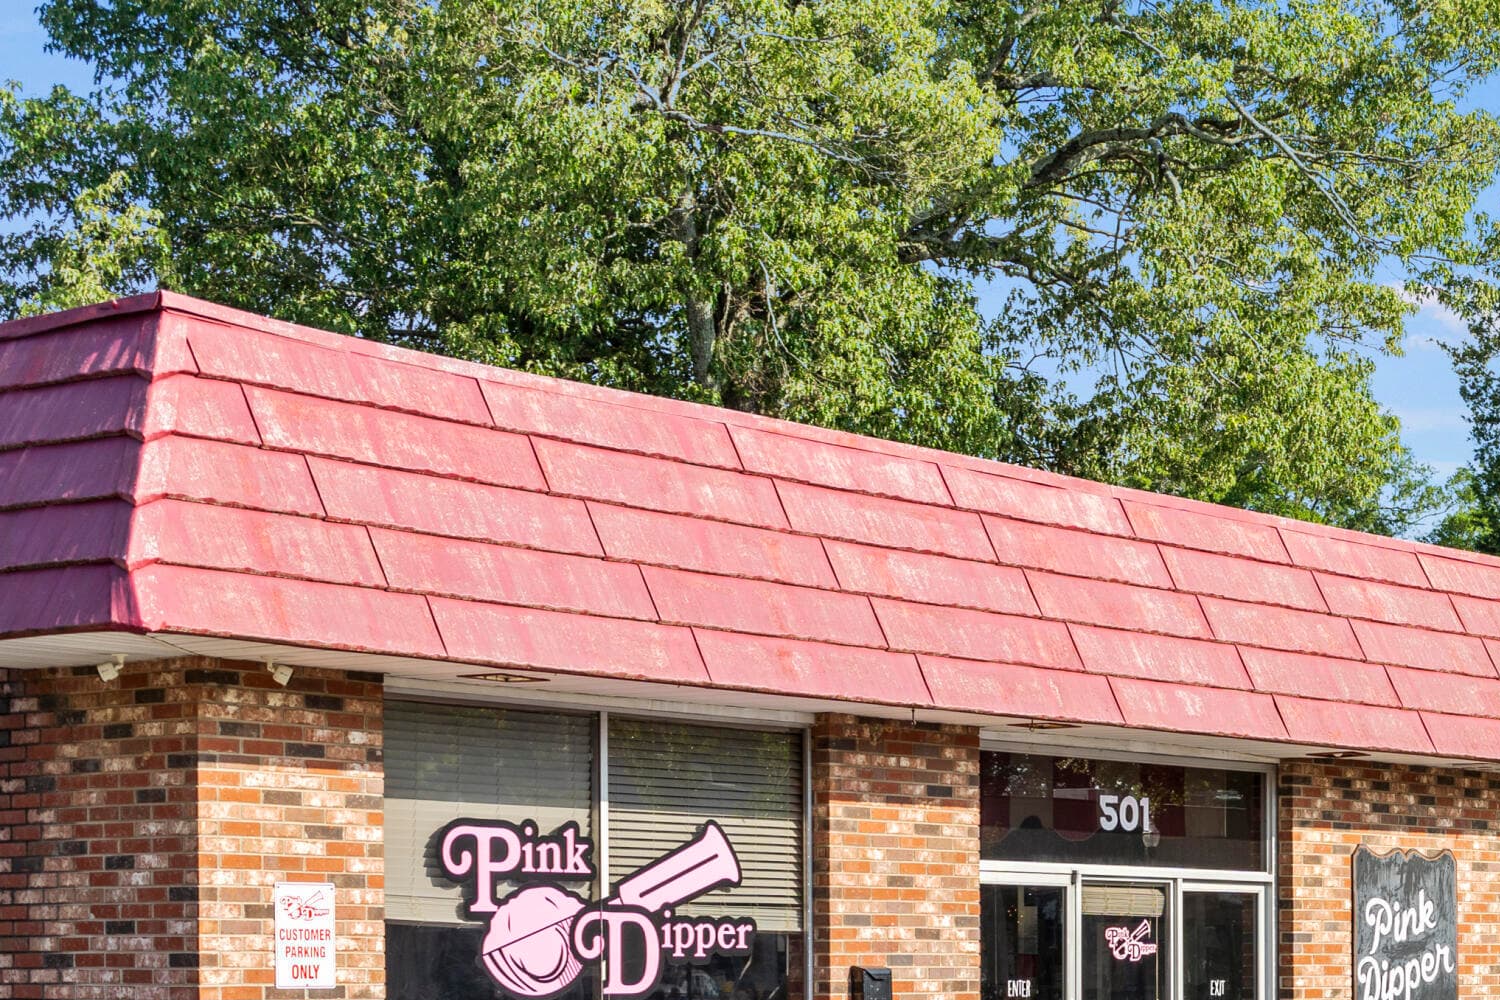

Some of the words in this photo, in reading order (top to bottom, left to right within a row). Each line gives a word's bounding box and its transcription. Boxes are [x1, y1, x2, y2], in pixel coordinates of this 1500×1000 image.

[1099, 795, 1149, 833] 501
[442, 825, 592, 912] Pink
[1365, 888, 1437, 955] Pink
[279, 928, 331, 941] CUSTOMER
[285, 946, 326, 958] PARKING
[573, 910, 753, 995] Dipper
[291, 964, 320, 980] ONLY
[1007, 979, 1031, 998] ENTER
[1210, 979, 1226, 996] EXIT
